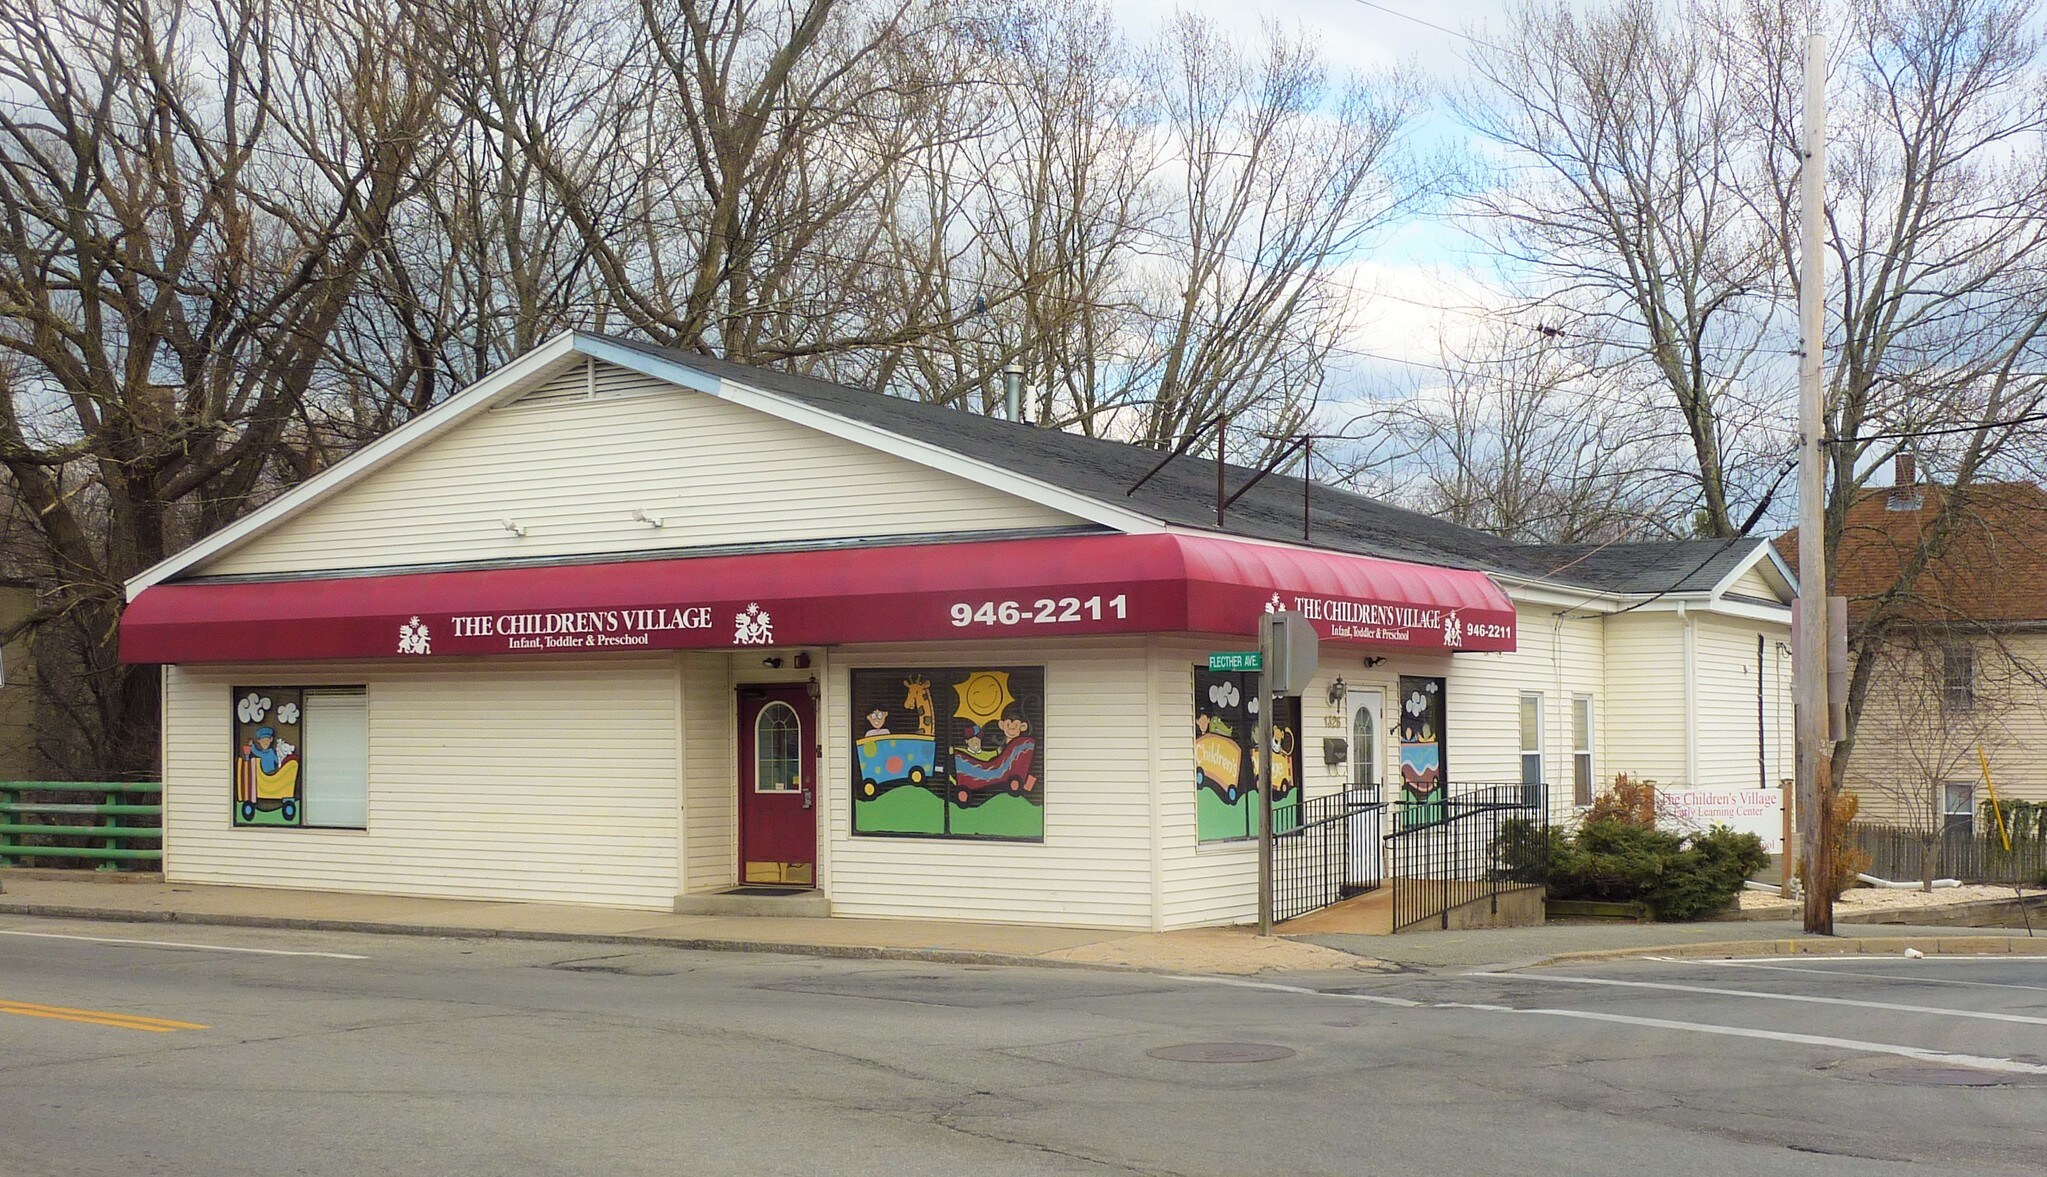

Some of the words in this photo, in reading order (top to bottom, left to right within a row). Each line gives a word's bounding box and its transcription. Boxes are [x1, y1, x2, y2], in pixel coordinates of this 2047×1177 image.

[950, 594, 1127, 627] 946-2211
[1294, 597, 1322, 620] THE
[1323, 600, 1394, 626] CHILDREN'S
[1395, 607, 1440, 629] VILLAGE
[451, 616, 494, 637] THE
[496, 611, 618, 635] CHILDREN'S
[621, 607, 713, 631] VILLAGE
[1331, 624, 1353, 639] Infant,
[1353, 626, 1375, 639] Toddler
[1375, 630, 1381, 639] &
[1382, 629, 1409, 641] Preschool
[1466, 623, 1511, 639] 946-2211
[509, 637, 544, 650] Infant,
[544, 634, 583, 647] Toddler
[585, 635, 595, 646] &
[597, 633, 648, 646] Preschool
[1209, 655, 1242, 668] FLECTHER
[1662, 793, 1680, 805] The
[1683, 792, 1737, 806] Children's
[1740, 792, 1777, 807] Village
[1698, 807, 1734, 818] Learning
[1736, 806, 1763, 816] Center
